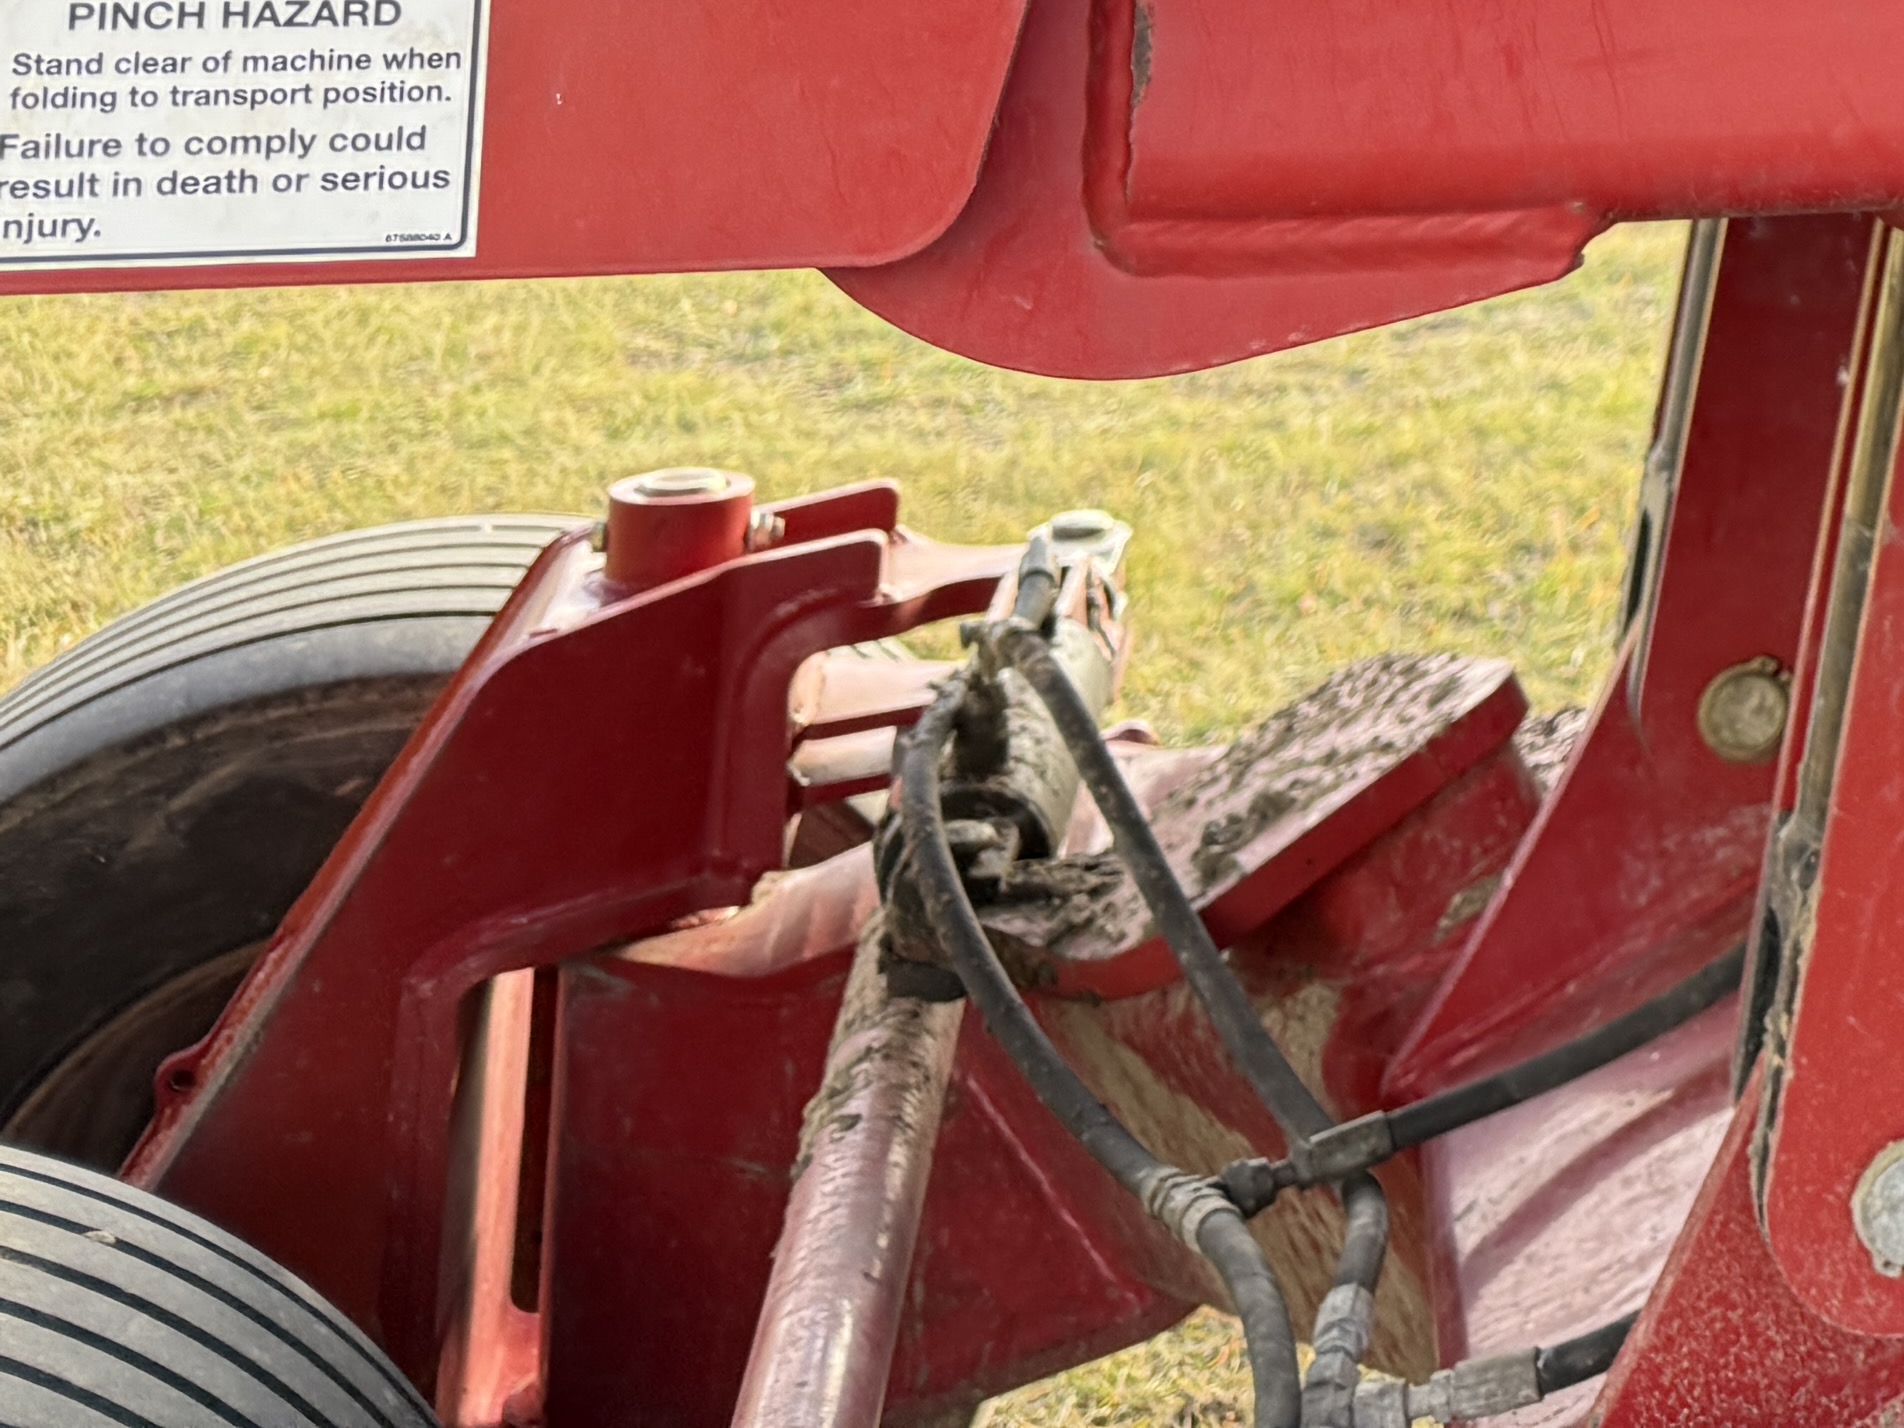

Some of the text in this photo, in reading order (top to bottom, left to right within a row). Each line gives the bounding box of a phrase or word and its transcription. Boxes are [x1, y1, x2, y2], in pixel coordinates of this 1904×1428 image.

[68, 1, 206, 31] PINCH
[12, 46, 462, 76] Stand clear of machine when
[9, 80, 452, 113] folding to transport position.
[0, 124, 427, 161] Failure to comply could
[112, 171, 143, 199] in
[156, 167, 260, 197] death
[271, 170, 310, 194] or
[319, 164, 451, 193] serious
[0, 214, 102, 244] njury.
